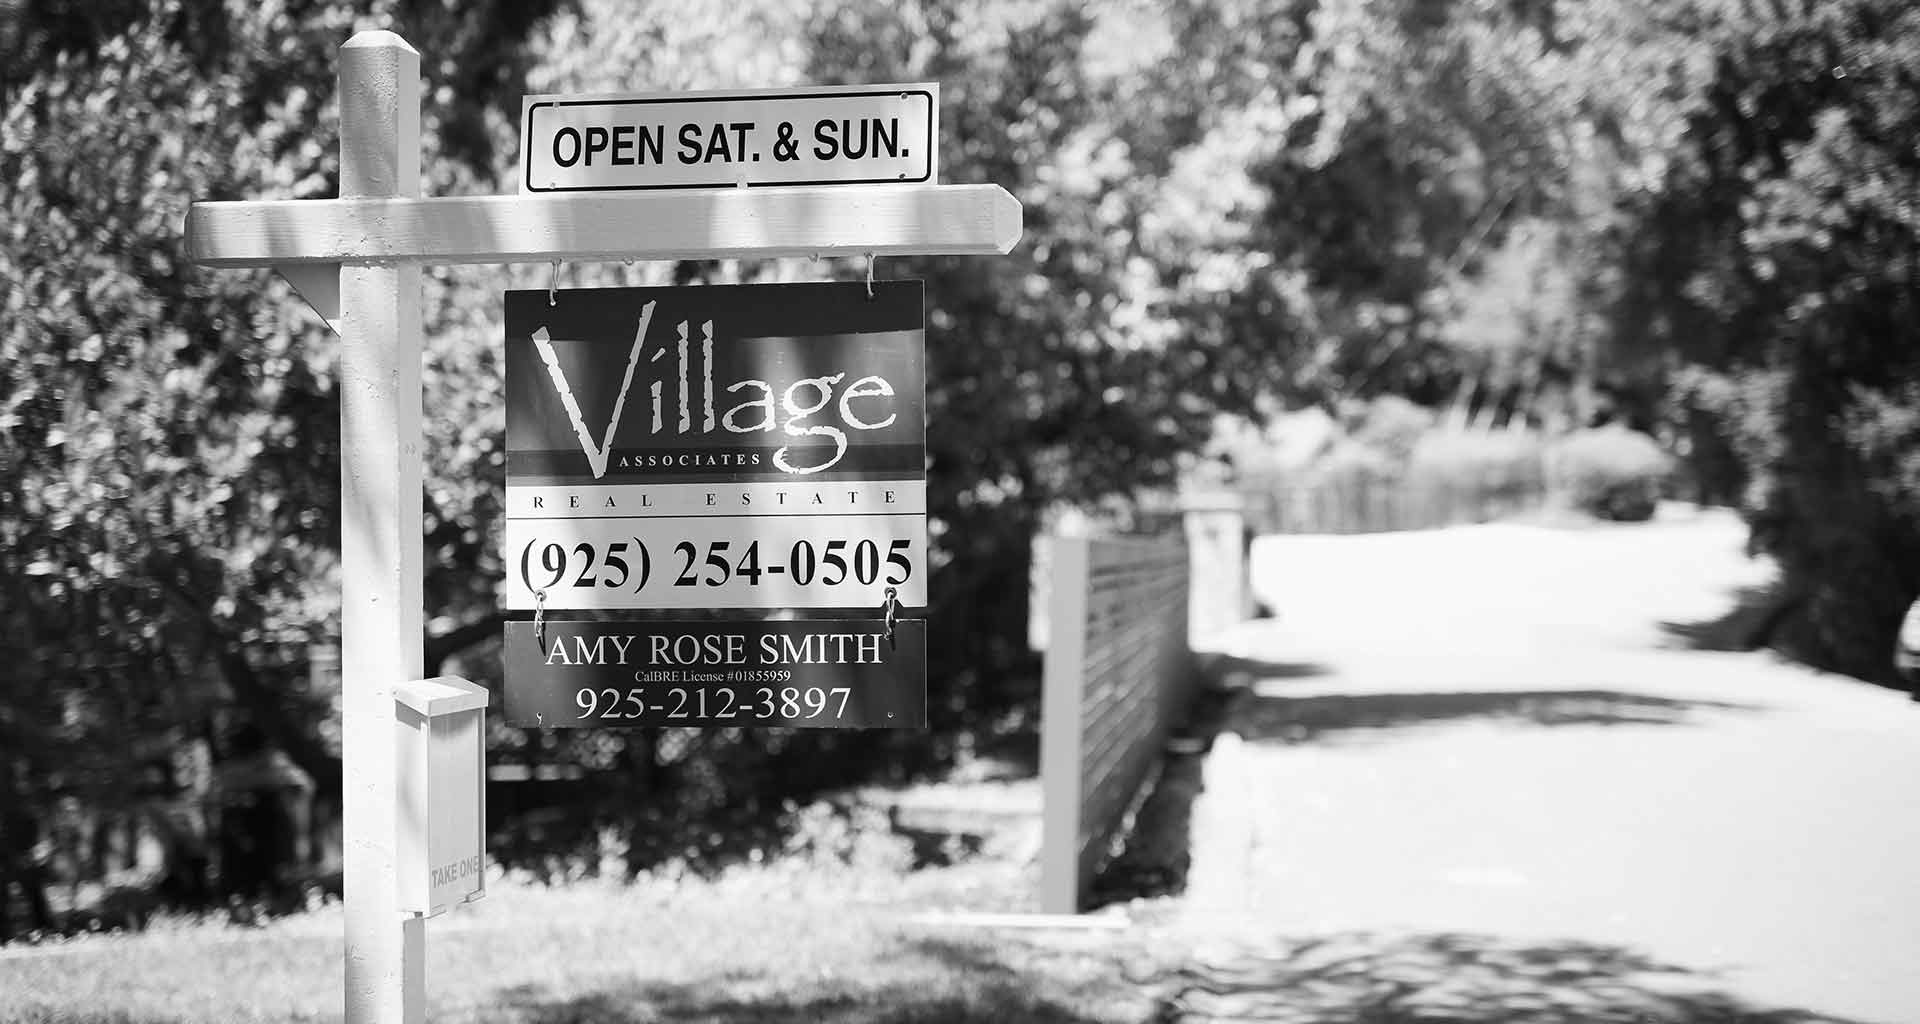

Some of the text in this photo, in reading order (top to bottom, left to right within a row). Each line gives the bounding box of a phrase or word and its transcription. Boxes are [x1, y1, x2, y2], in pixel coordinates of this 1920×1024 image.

[553, 118, 910, 167] OPEN SAT. & SUN.
[531, 300, 897, 479] Village
[619, 453, 761, 467] ASSOCIATES
[532, 491, 895, 509] REAL ESTATE
[520, 536, 911, 594] (925) 254-0505
[545, 633, 883, 665] AMY ROSE SMITH
[634, 670, 791, 682] CalBRE License #01855959
[576, 686, 850, 720] 925-212-3897
[432, 855, 479, 888] TAKE ONE
